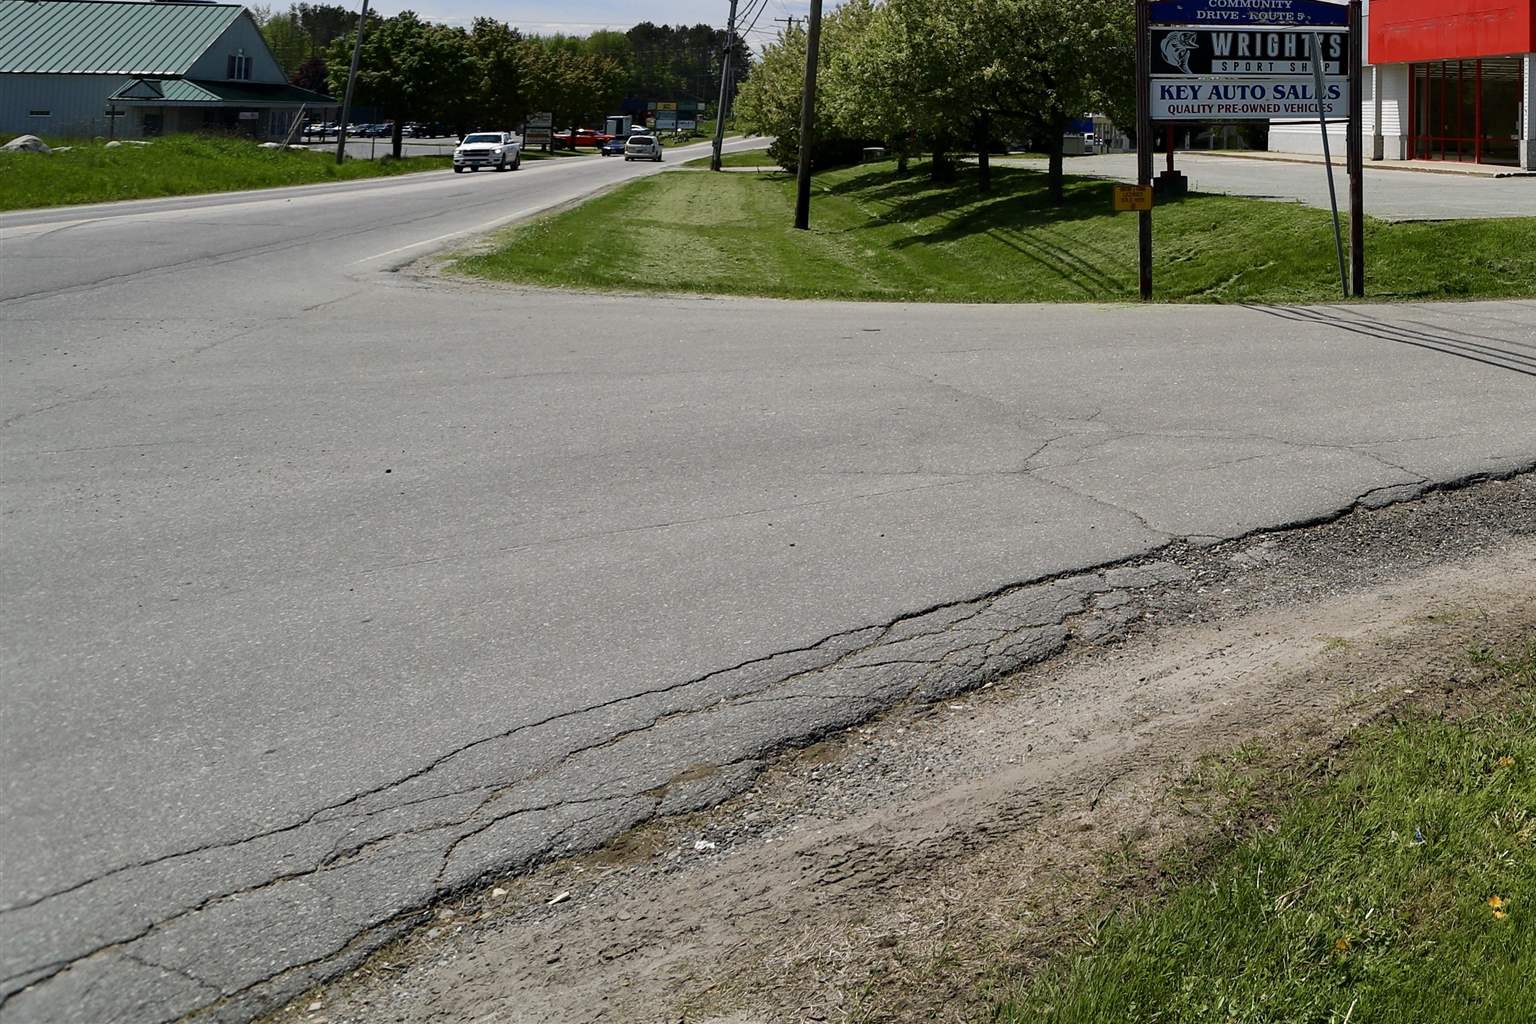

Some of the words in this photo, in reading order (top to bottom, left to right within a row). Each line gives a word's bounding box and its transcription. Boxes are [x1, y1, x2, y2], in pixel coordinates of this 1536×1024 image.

[1196, 10, 1239, 20] DRIVE
[1249, 11, 1294, 21] ROUTE
[1221, 61, 1274, 72] SPORT
[1290, 62, 1330, 72] SHP
[1160, 84, 1203, 100] KEY
[1207, 84, 1266, 100] AUTO
[1168, 104, 1213, 115] QUALITY
[1217, 103, 1280, 114] PRE-OWNED
